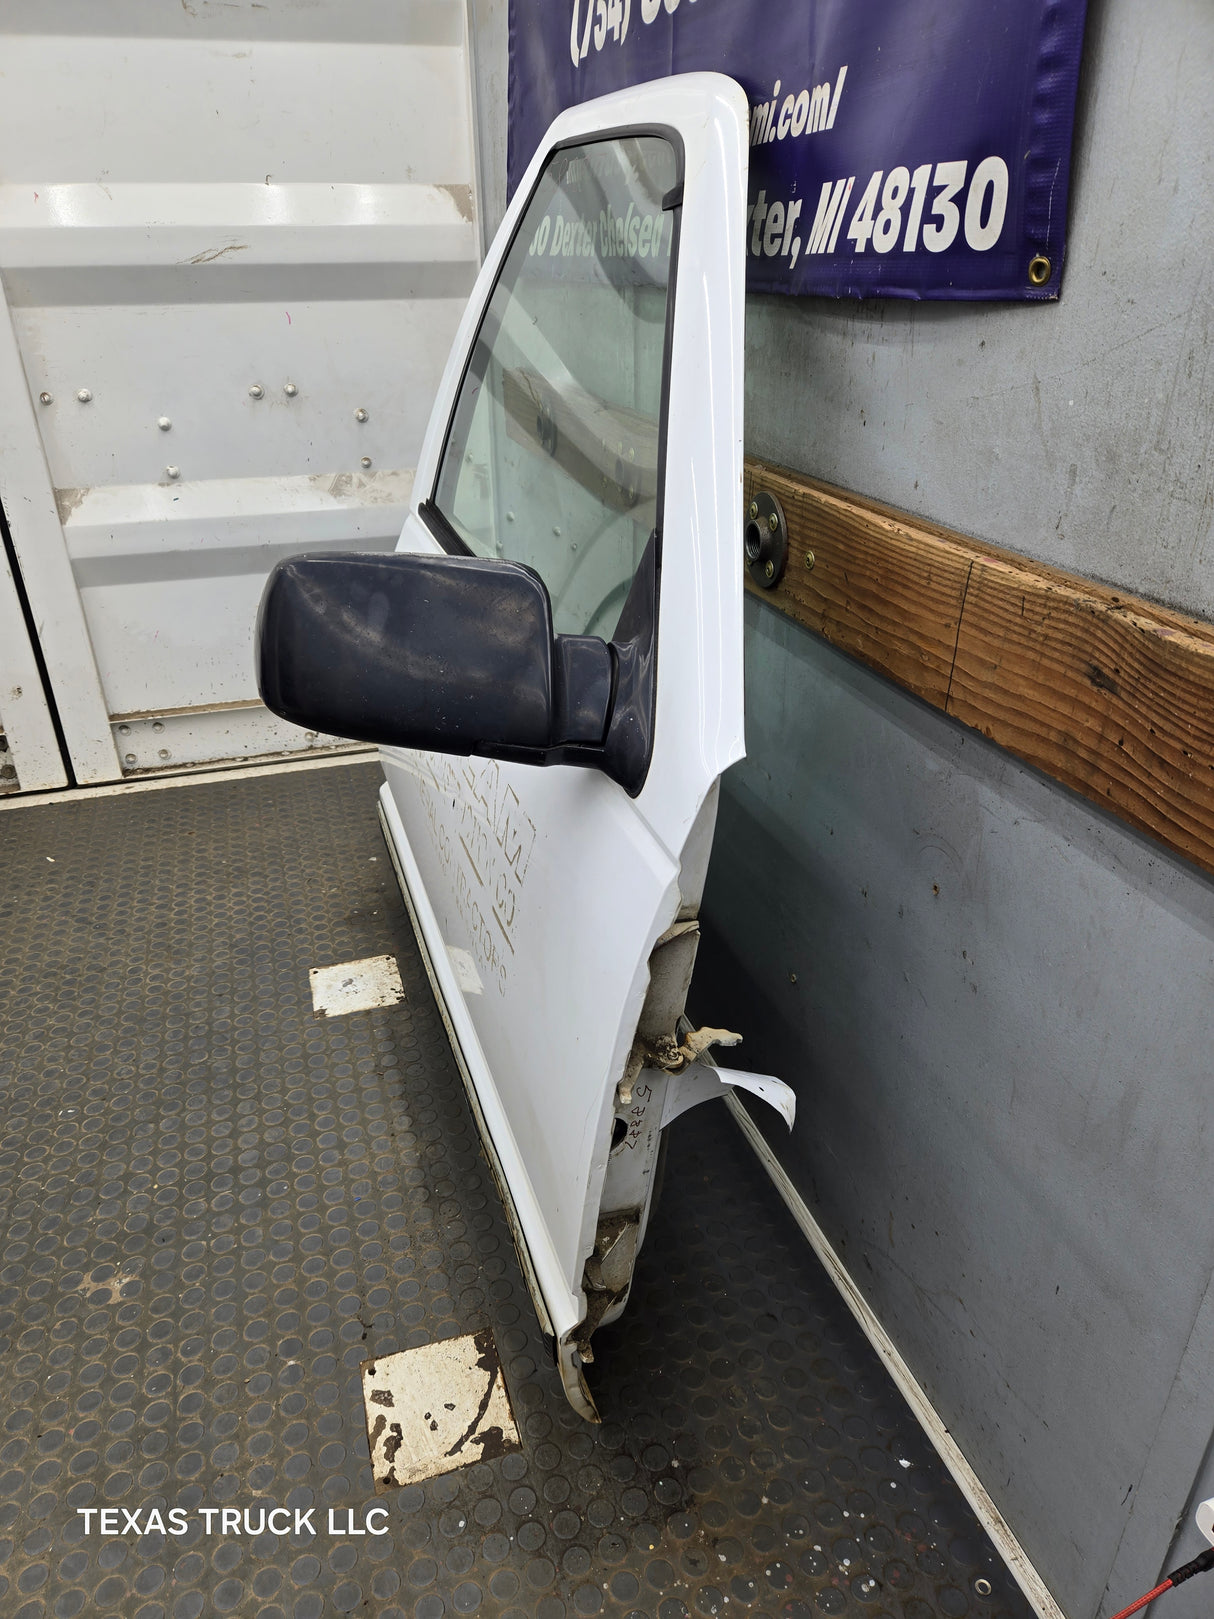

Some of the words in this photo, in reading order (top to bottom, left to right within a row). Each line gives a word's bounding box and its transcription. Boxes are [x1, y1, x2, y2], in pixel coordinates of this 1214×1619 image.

[550, 214, 597, 257] Dexter
[600, 202, 664, 258] Chelsea
[747, 190, 803, 269] ter,
[805, 176, 856, 255] MI
[847, 155, 1009, 253] 48130
